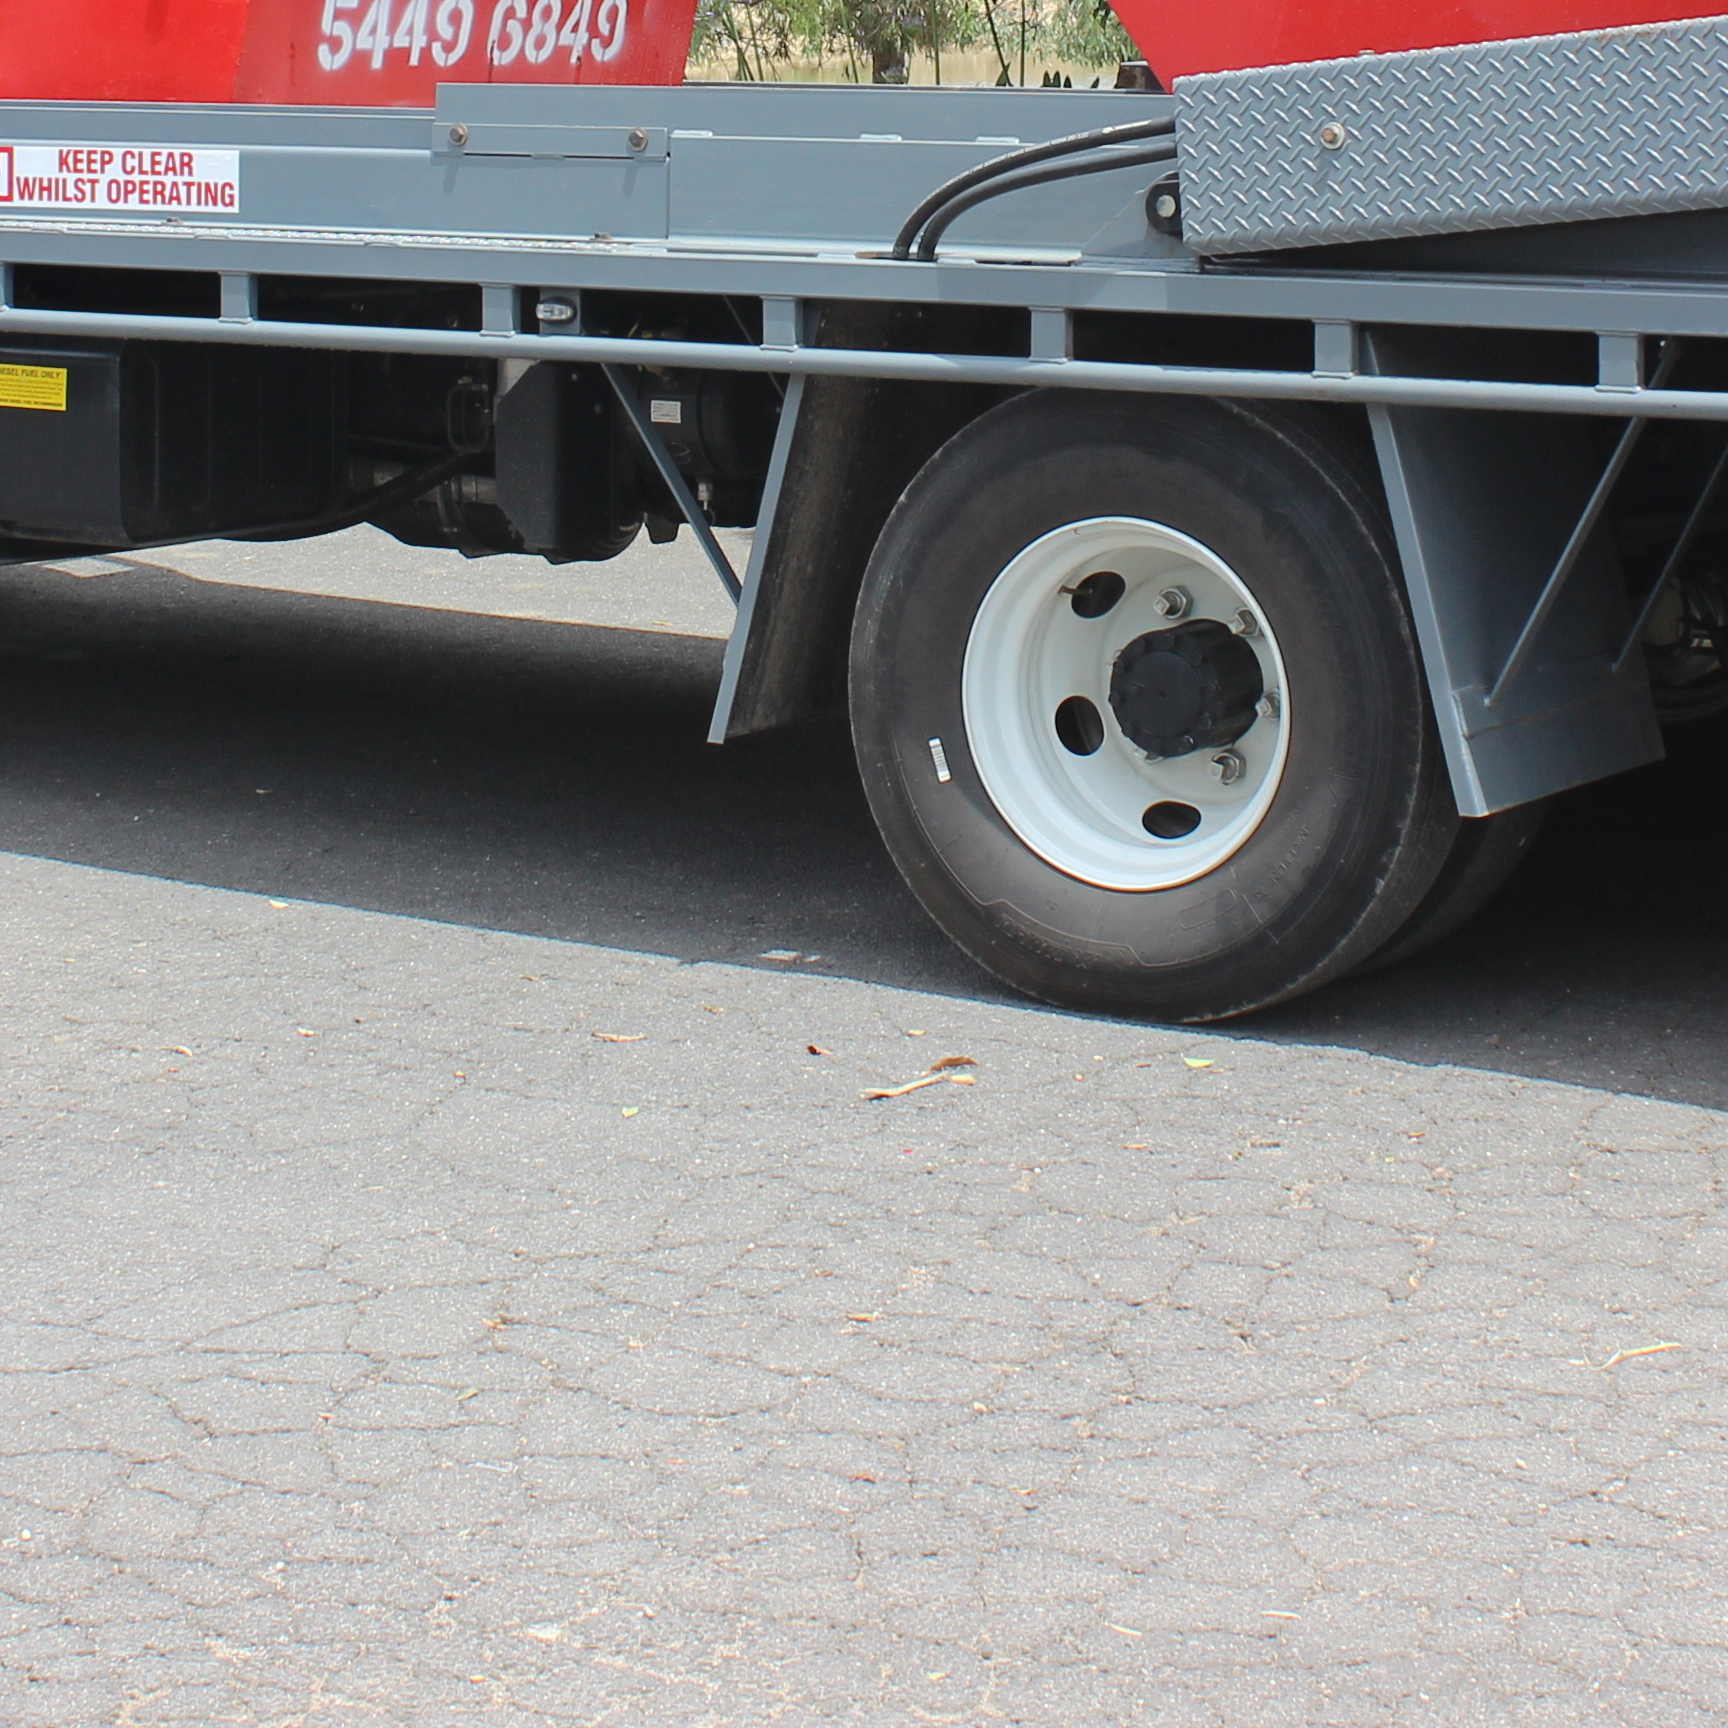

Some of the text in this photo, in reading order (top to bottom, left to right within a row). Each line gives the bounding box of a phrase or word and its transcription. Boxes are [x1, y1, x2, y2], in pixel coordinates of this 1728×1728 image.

[57, 149, 194, 177] KEEP CLEAR
[15, 176, 235, 208] WHILST OPERATING
